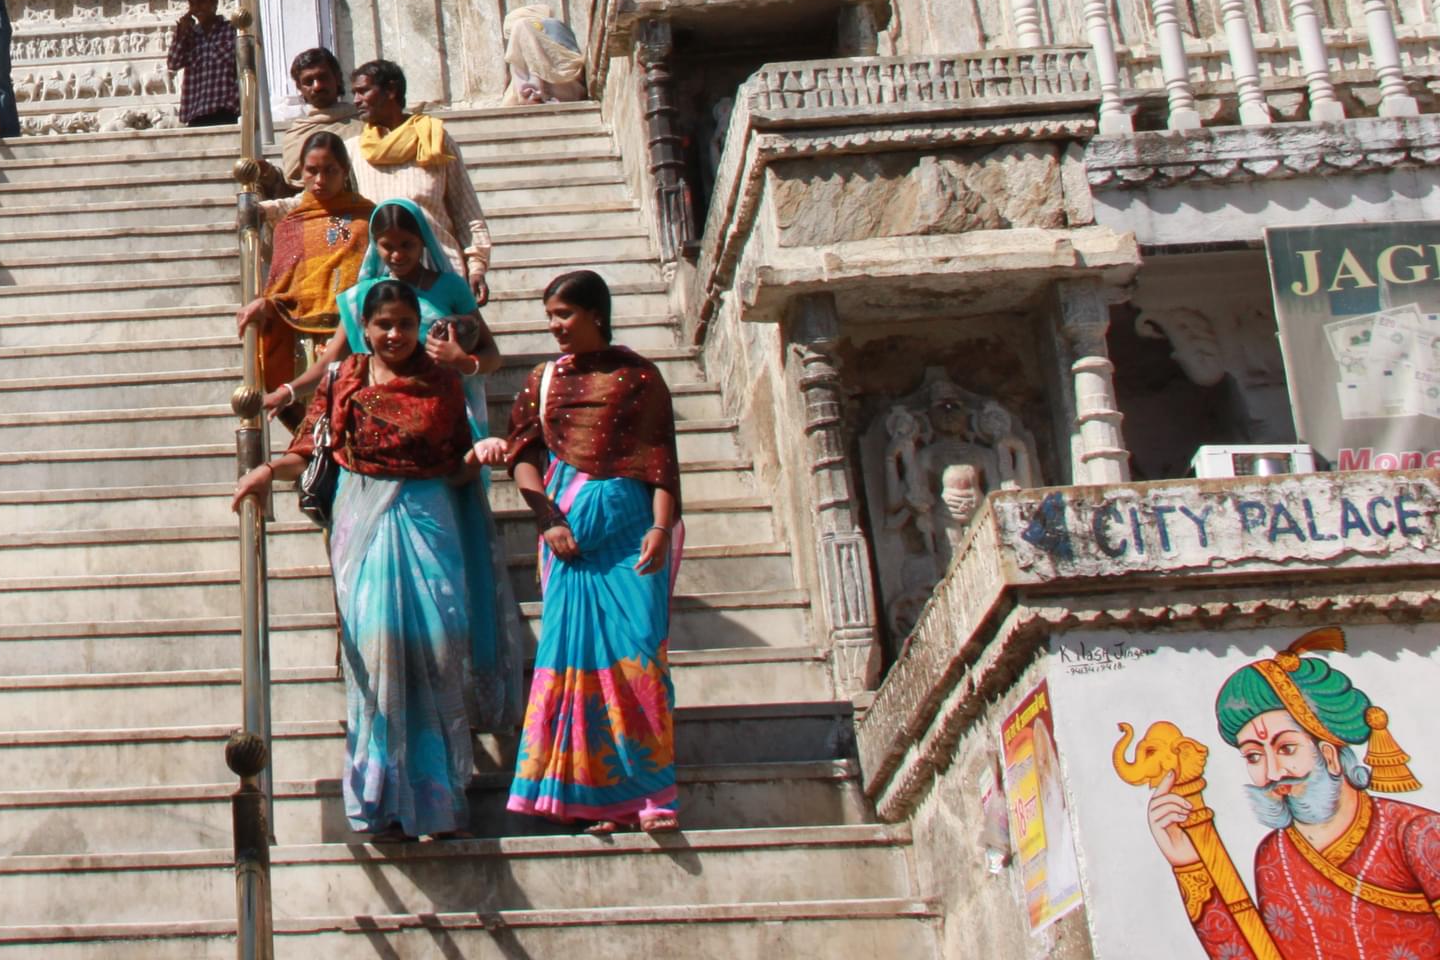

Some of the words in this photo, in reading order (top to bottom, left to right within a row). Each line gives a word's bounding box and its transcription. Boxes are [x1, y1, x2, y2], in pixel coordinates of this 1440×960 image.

[1291, 244, 1440, 297] JAG
[1091, 505, 1212, 557] CITY
[1238, 495, 1426, 544] PALACE
